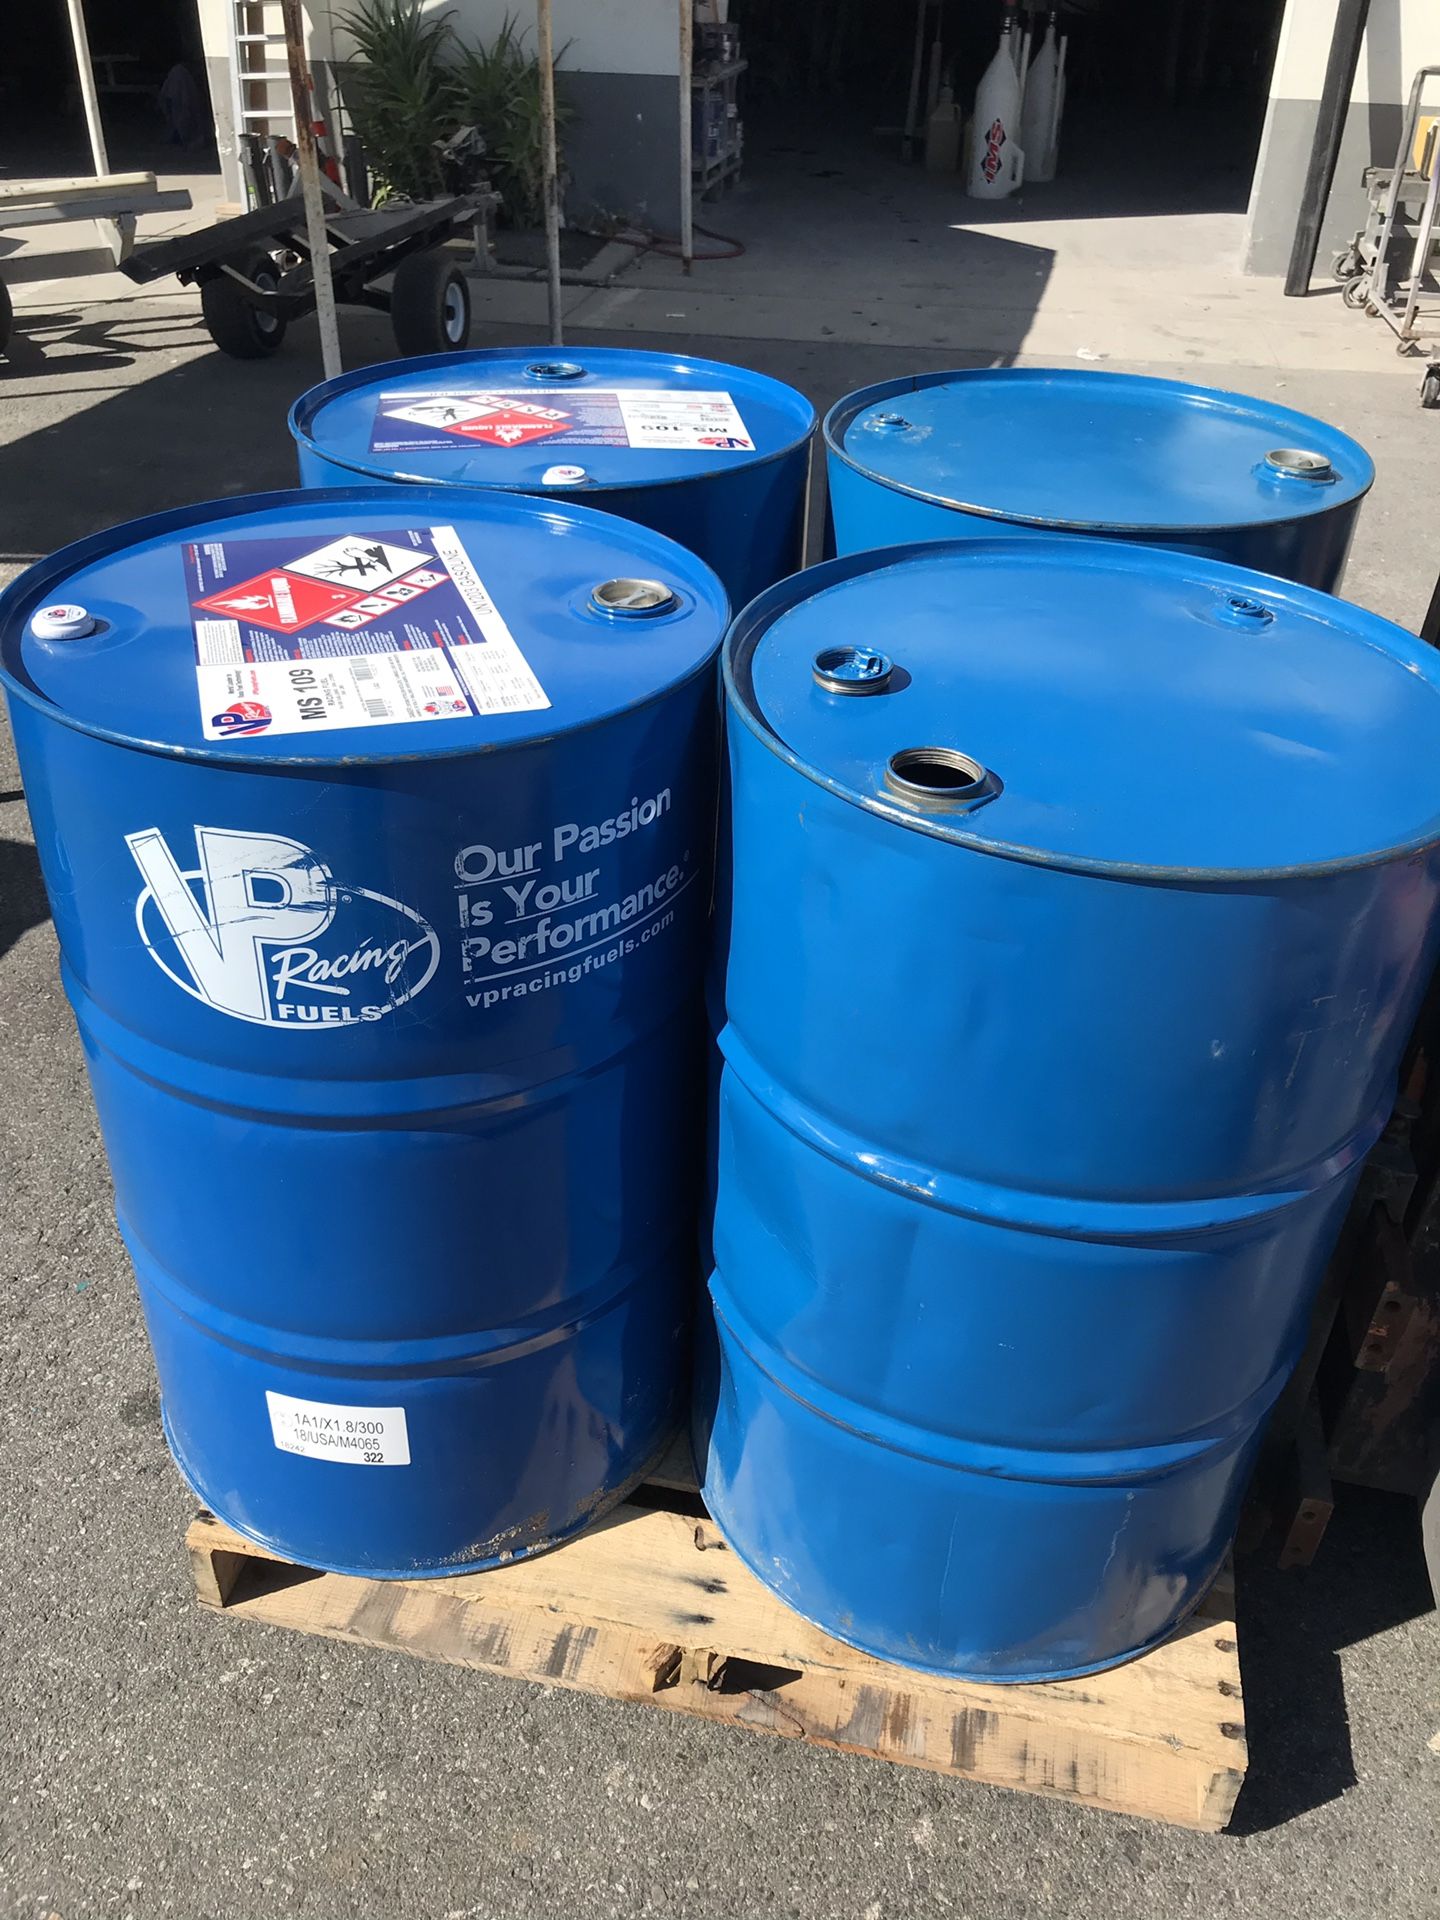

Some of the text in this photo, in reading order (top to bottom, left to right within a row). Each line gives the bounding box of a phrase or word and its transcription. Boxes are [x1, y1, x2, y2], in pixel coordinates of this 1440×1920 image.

[288, 668, 327, 720] MS 109
[211, 713, 272, 736] VP
[454, 787, 671, 883] Our Passion
[124, 824, 337, 1022] VP
[458, 868, 600, 928] Is Your
[271, 936, 410, 1000] Racing
[465, 910, 674, 1008] vpracingfuels.com
[278, 1003, 383, 1022] FUELS
[293, 1428, 381, 1450] 18/USA/M4065
[294, 1413, 384, 1435] 1A1/X1.8/300
[363, 1452, 384, 1463] 322
